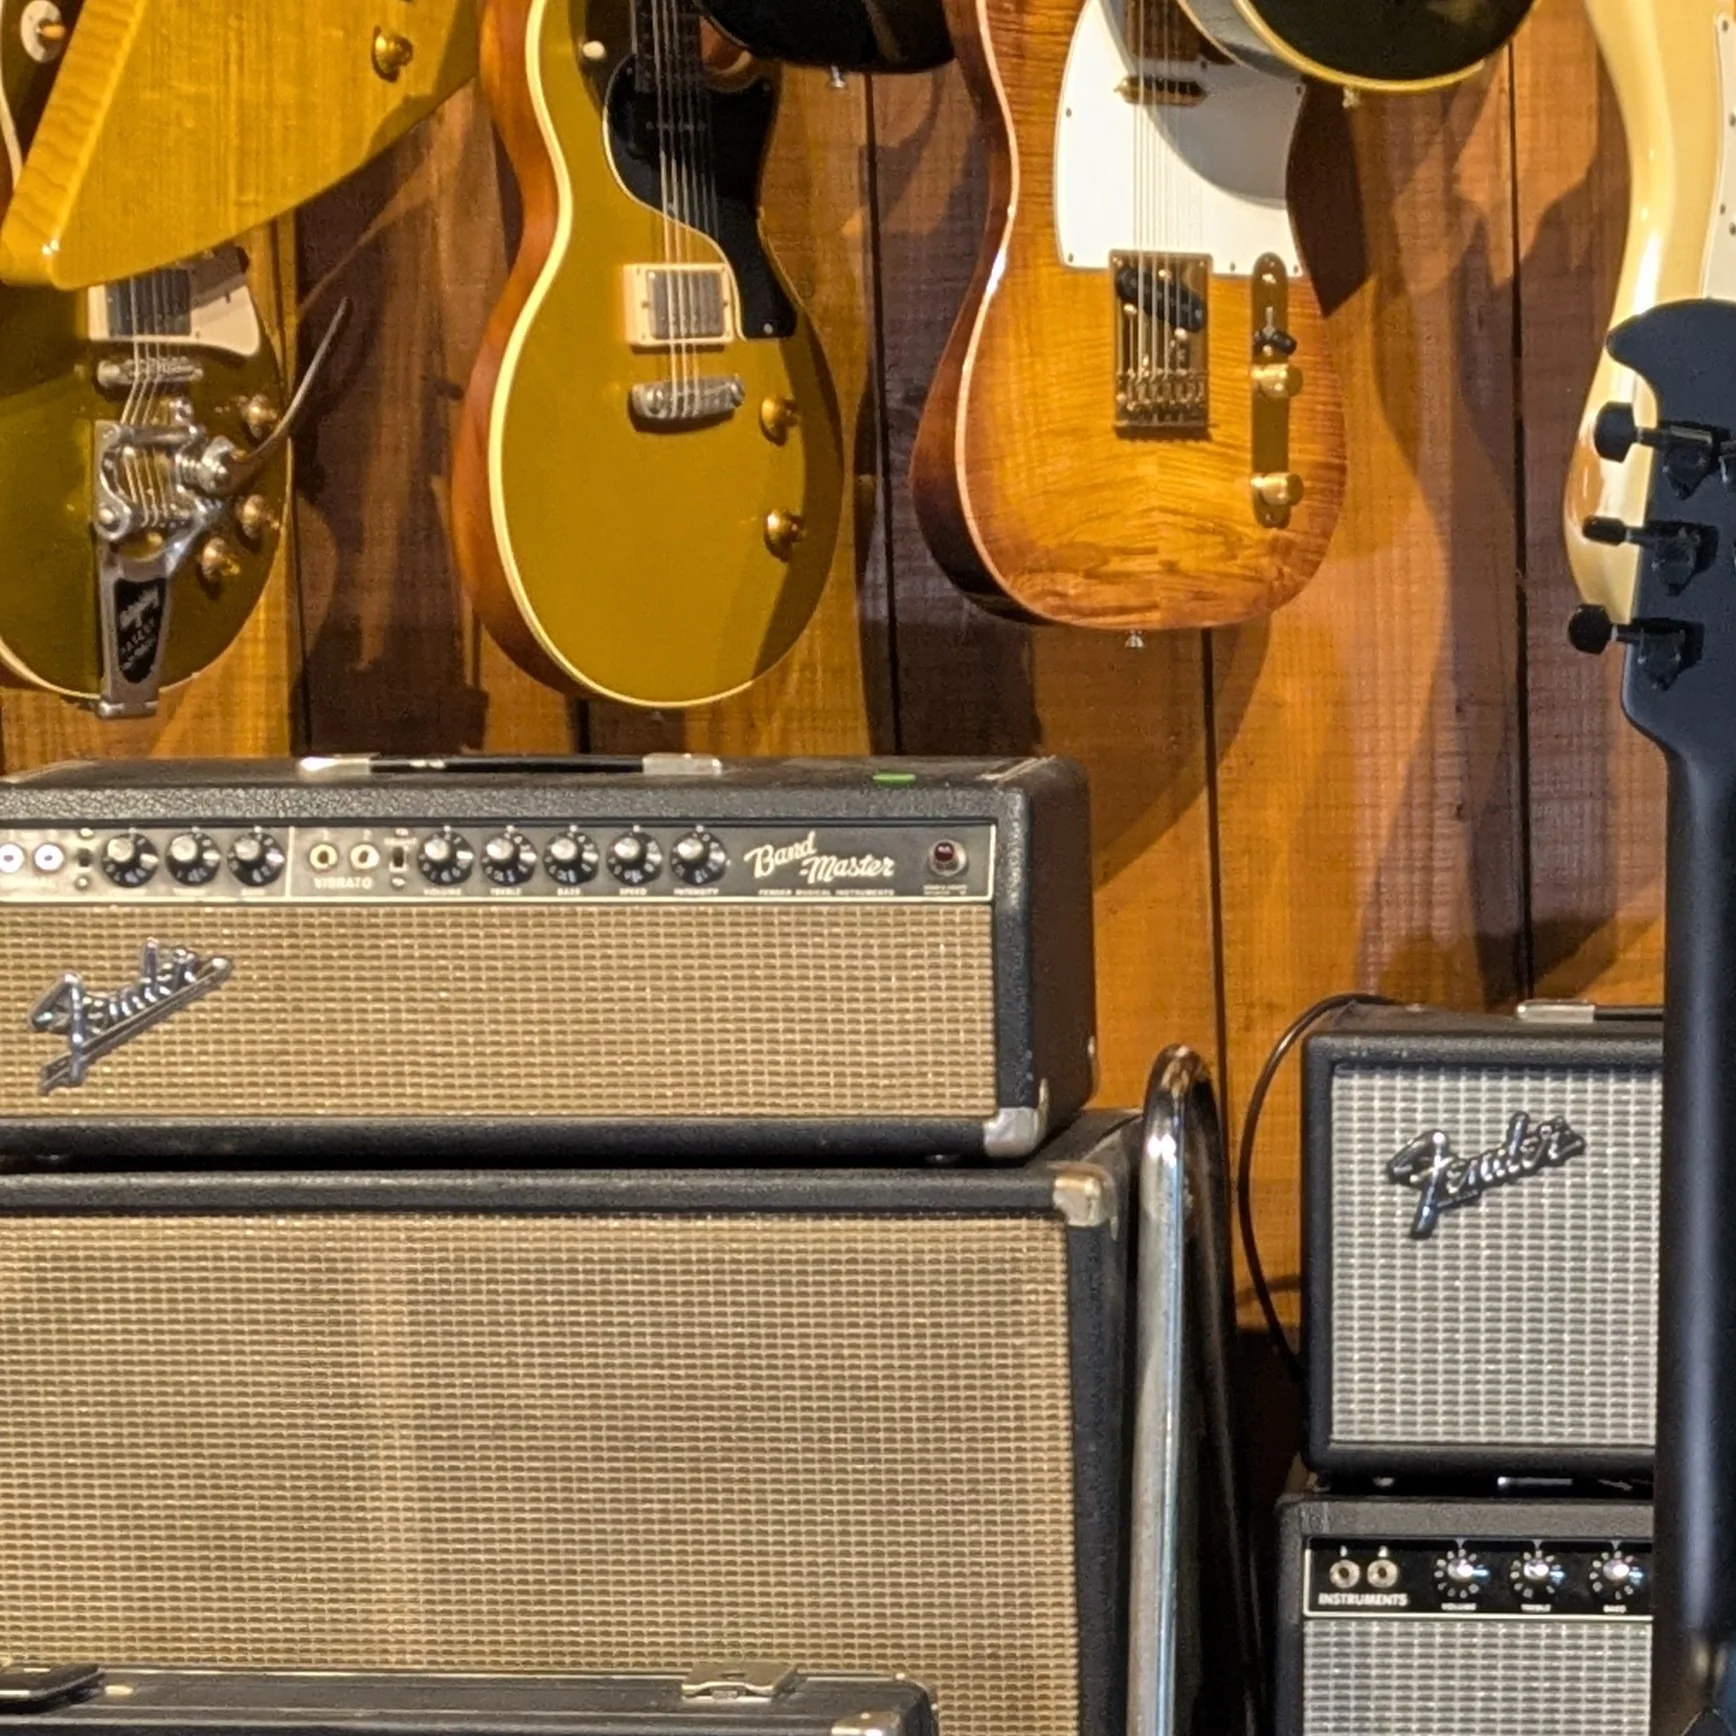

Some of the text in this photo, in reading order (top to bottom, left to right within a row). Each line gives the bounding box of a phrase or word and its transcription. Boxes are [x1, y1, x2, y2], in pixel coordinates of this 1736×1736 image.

[743, 829, 818, 879] Band
[313, 877, 374, 890] VIBRATO
[619, 887, 648, 896] SPEED
[758, 888, 895, 896] FENDER MUSICAL INSTRUMENTS
[29, 936, 233, 1096] Fender
[1387, 1110, 1587, 1240] Fender
[1318, 1593, 1409, 1607] INSTRUMENTS
